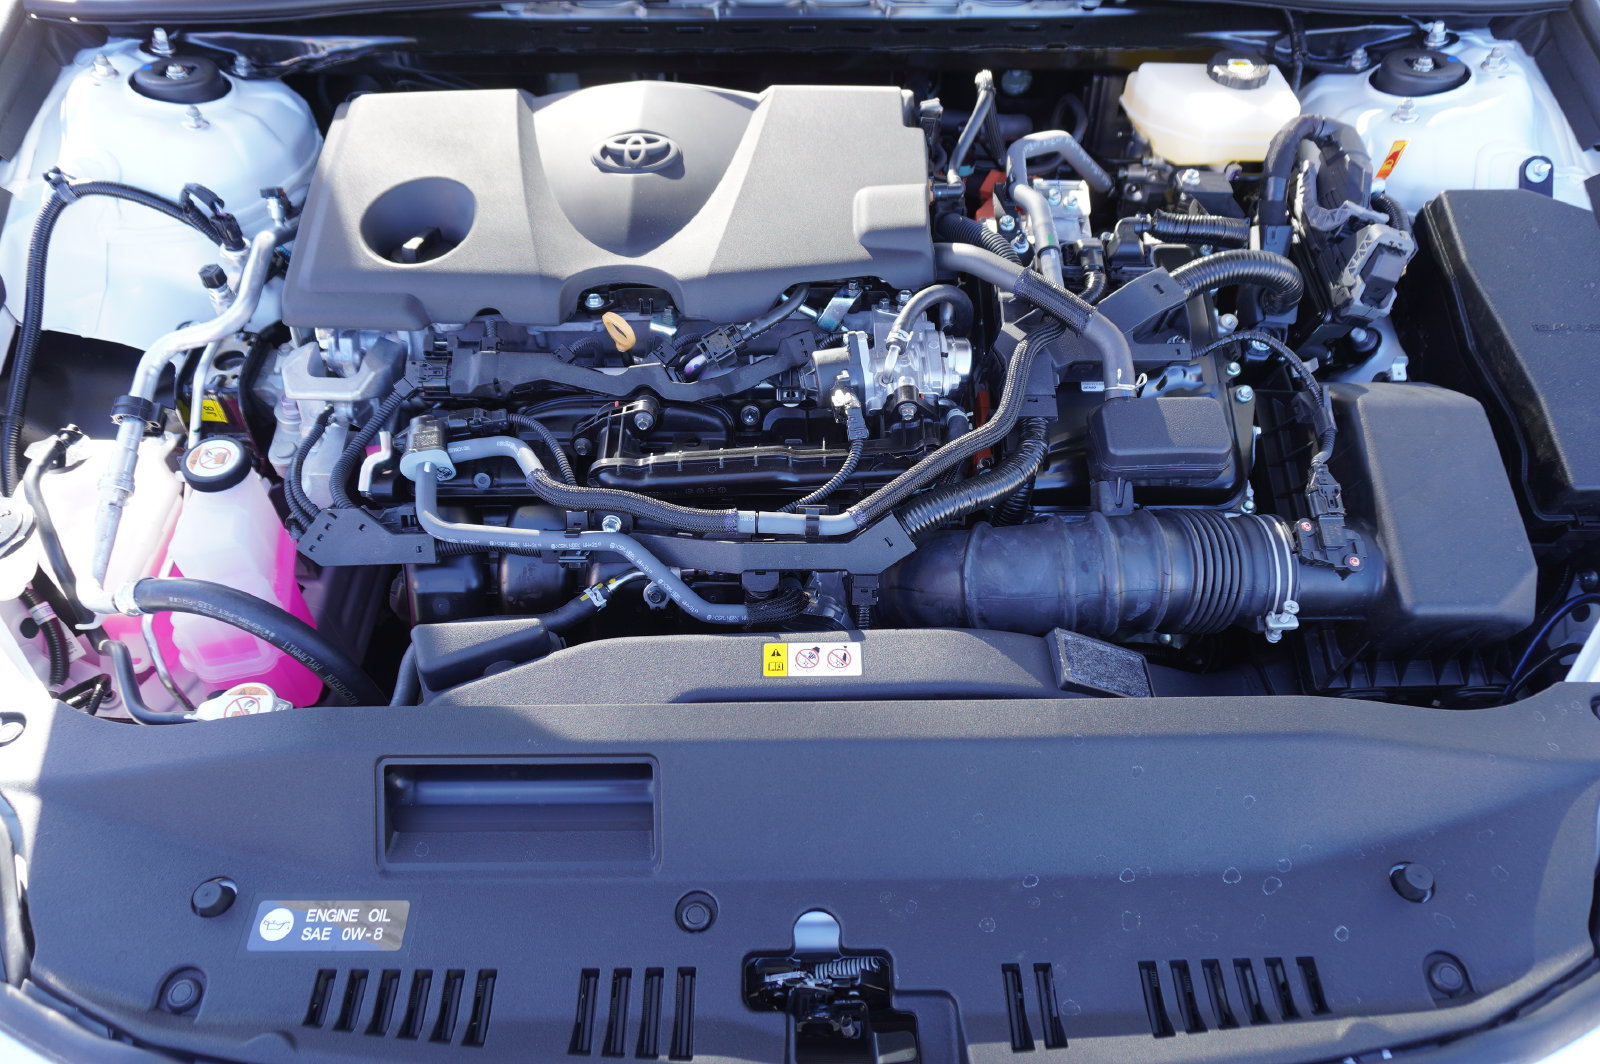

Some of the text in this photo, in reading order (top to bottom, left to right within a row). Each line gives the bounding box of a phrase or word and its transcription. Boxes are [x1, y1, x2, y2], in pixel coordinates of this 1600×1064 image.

[306, 908, 391, 922] ENGINE OIL
[301, 927, 384, 941] SAE 0W-8
